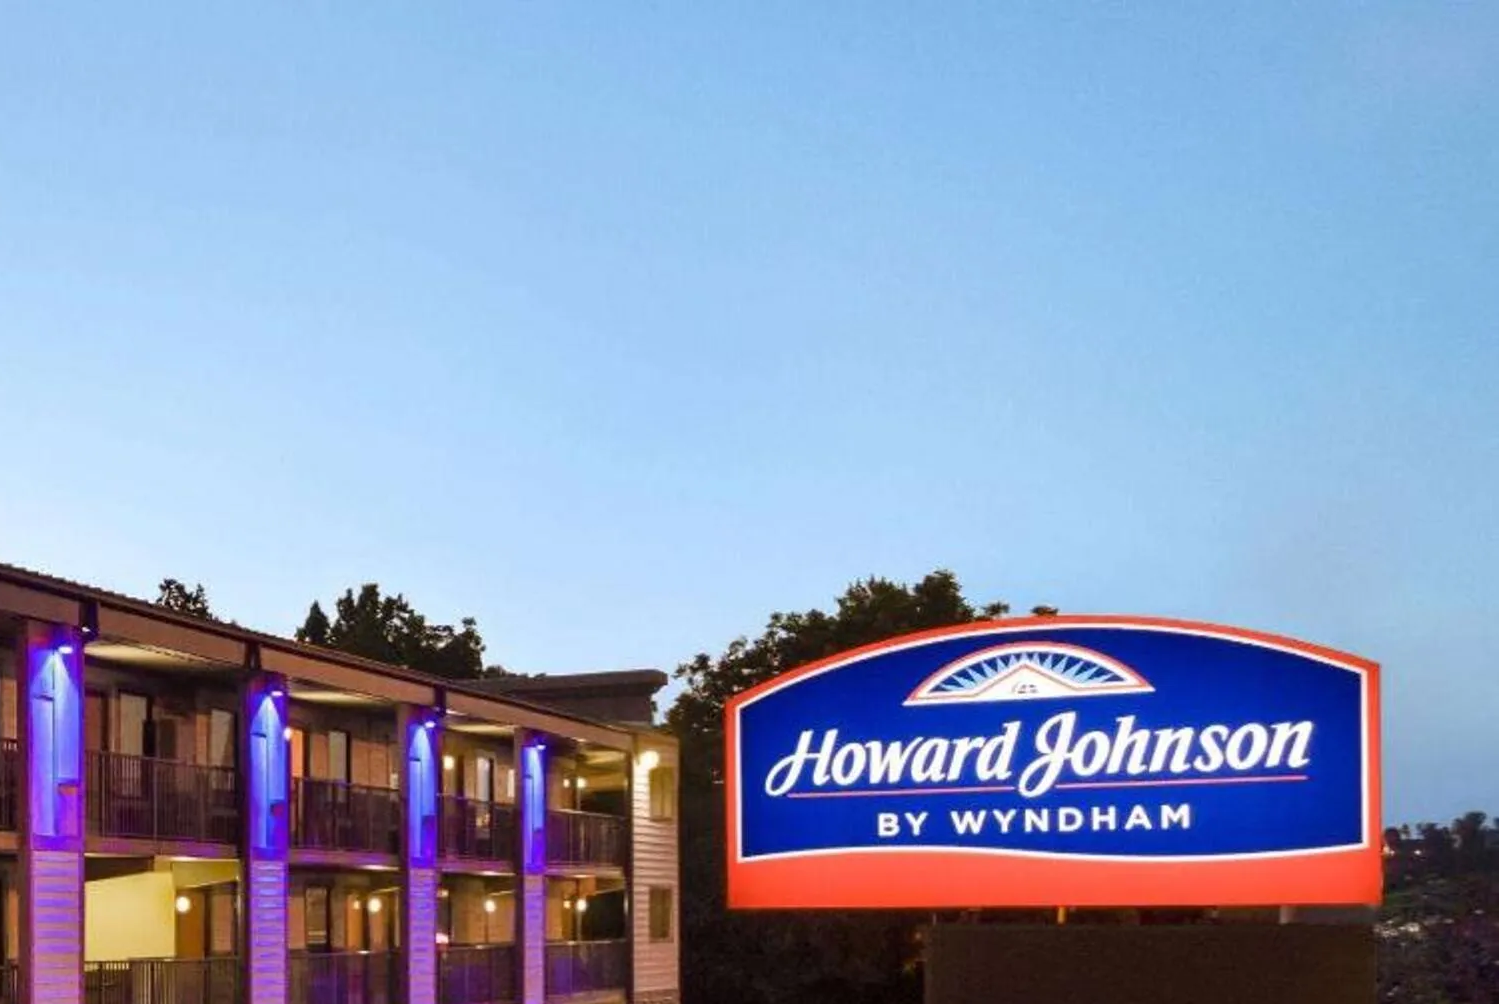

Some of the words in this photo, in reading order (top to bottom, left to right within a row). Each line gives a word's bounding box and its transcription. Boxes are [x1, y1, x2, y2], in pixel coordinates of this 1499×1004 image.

[765, 720, 1021, 797] Howard
[1017, 711, 1314, 798] Johnson
[878, 812, 929, 837] BY
[950, 803, 1192, 835] WYNDHAM
